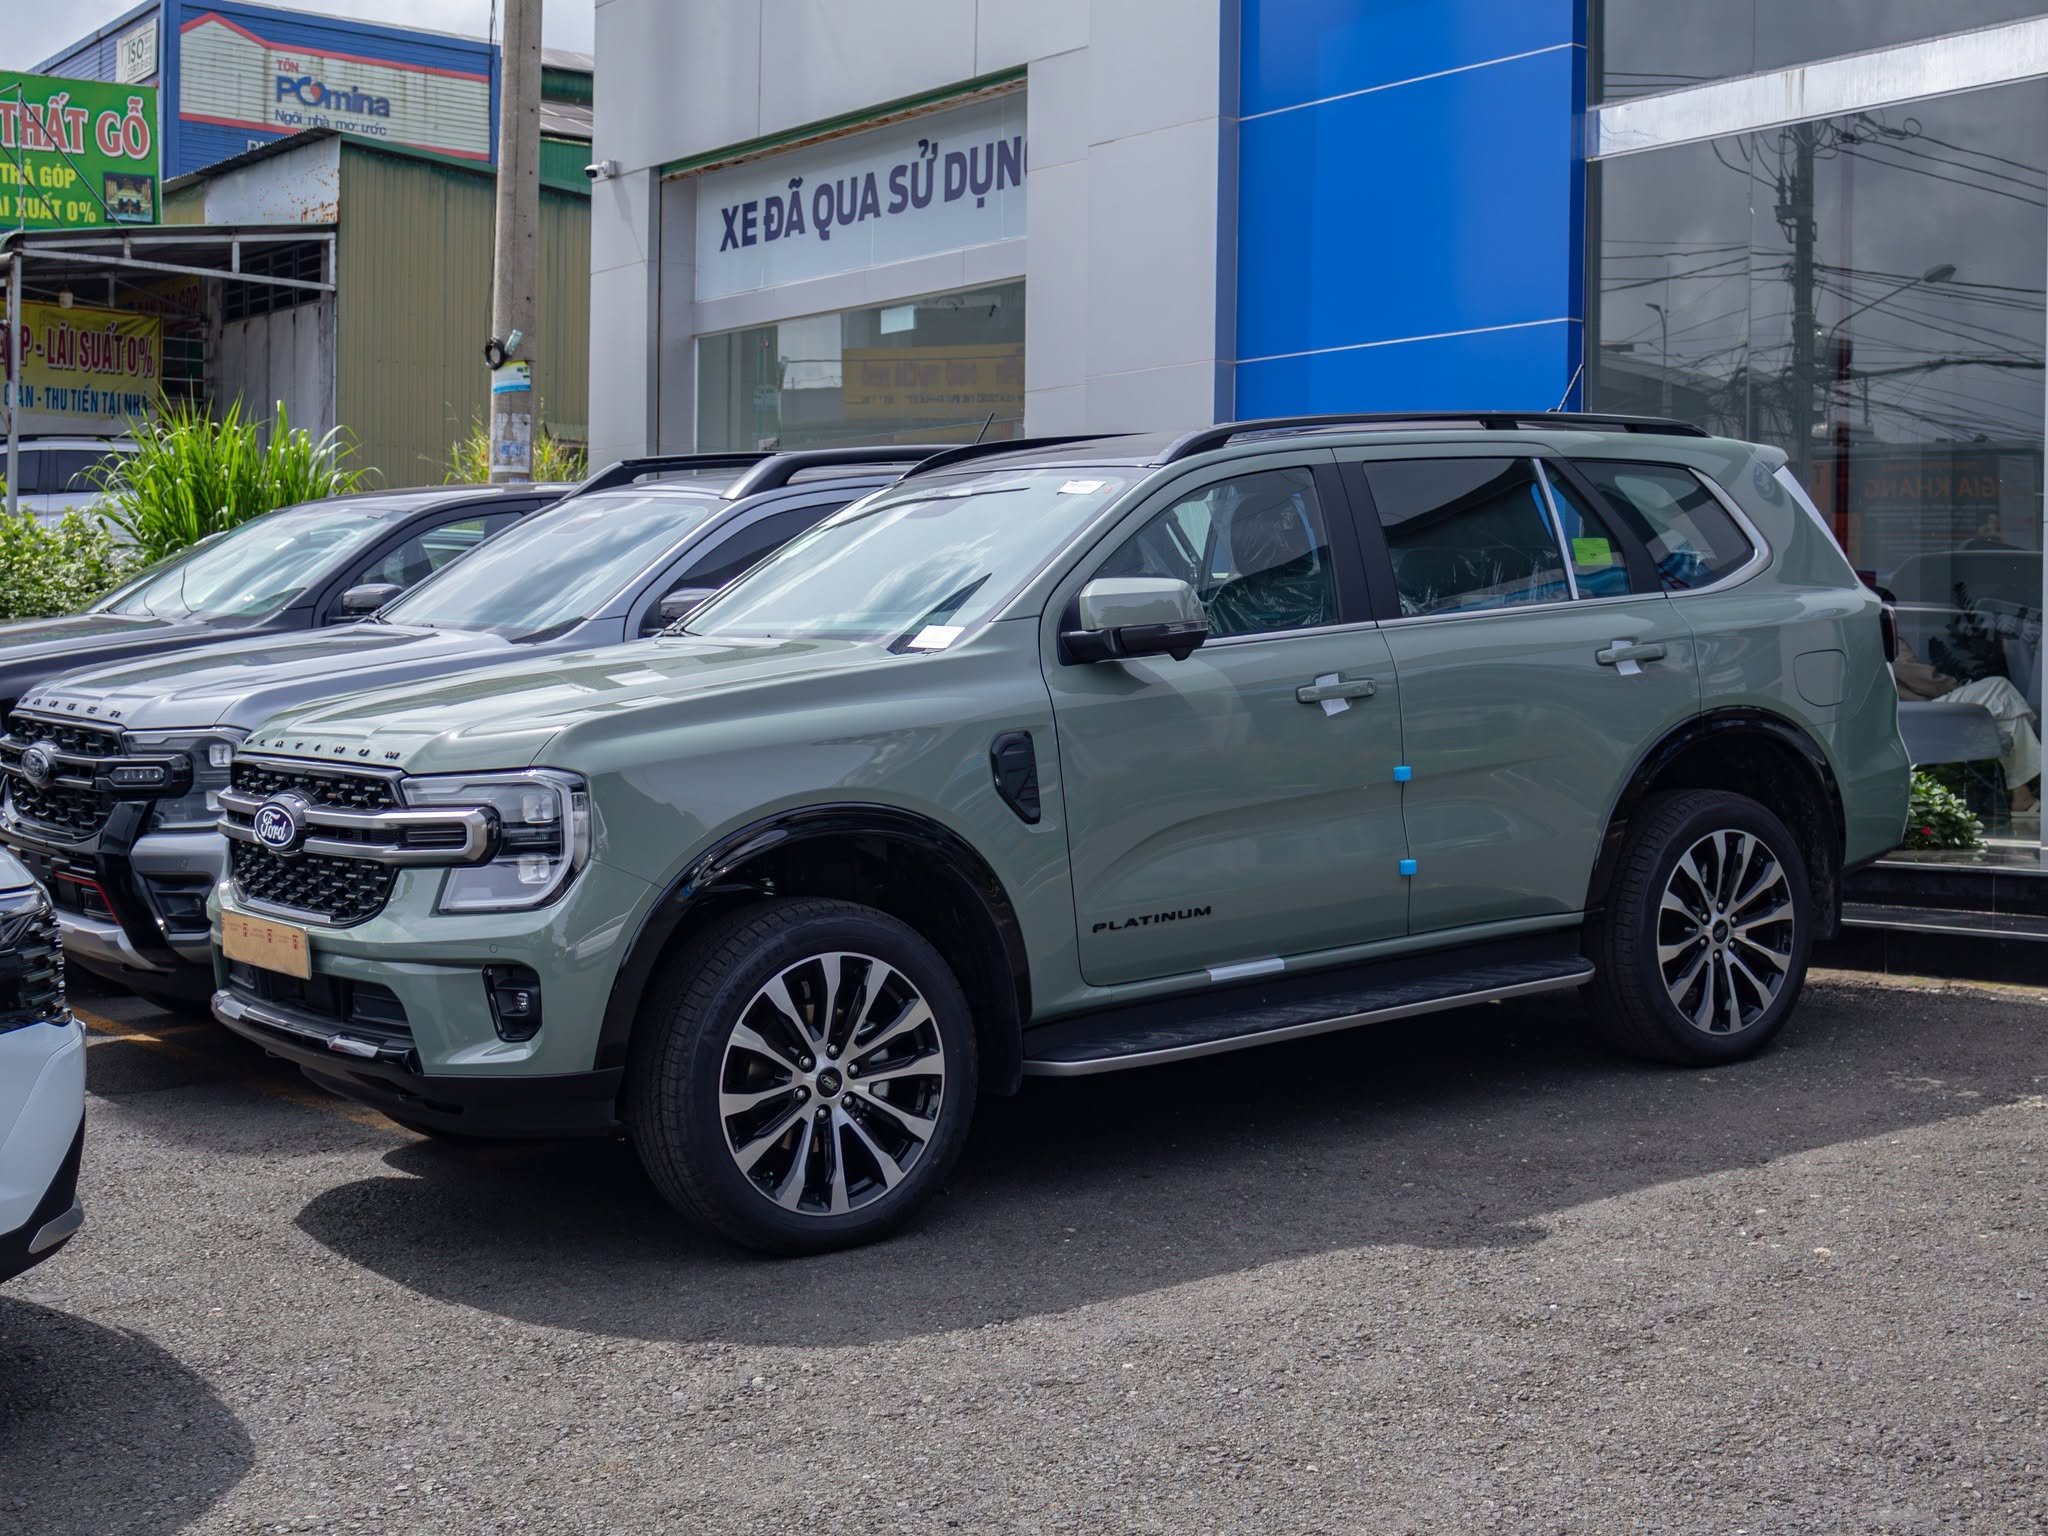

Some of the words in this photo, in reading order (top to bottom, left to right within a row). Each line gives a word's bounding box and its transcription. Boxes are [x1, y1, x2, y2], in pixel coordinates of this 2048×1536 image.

[127, 38, 144, 65] ISO
[276, 58, 300, 73] TÔN
[0, 92, 89, 154] THẤT
[95, 96, 151, 160] GỖ
[0, 158, 36, 186] TRẢ
[40, 162, 77, 189] GÓP
[15, 192, 63, 220] XUẤT
[66, 201, 97, 224] 0%
[720, 201, 758, 252] XE
[763, 176, 806, 243] ĐÃ
[812, 172, 882, 241] QUA
[887, 138, 939, 214] SỬ
[944, 135, 1027, 208] DỤN
[47, 320, 75, 369] LÃI
[79, 321, 124, 374] SUẤT
[127, 335, 154, 377] 0%
[45, 386, 68, 411] THU
[102, 390, 121, 420] TẠI
[21, 697, 121, 718] RANGER
[246, 738, 400, 760] PLATINUM
[260, 810, 288, 841] Ford
[1092, 906, 1212, 934] PLATINUM
